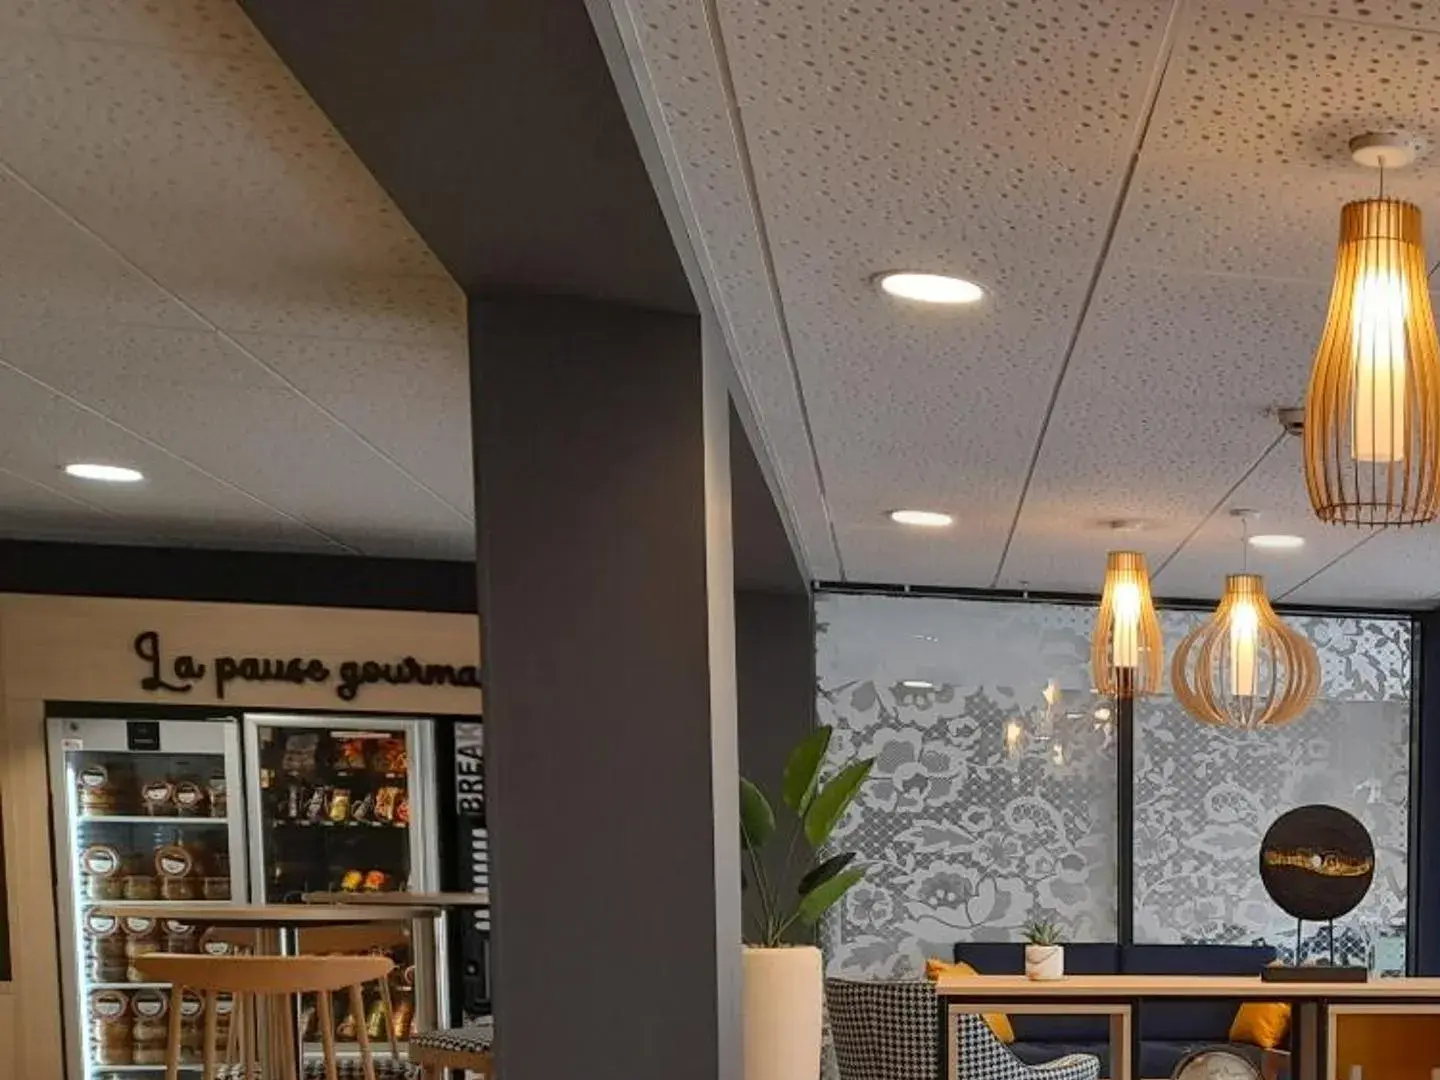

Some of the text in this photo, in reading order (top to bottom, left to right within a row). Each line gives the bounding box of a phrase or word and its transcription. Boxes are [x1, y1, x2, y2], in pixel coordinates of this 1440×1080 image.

[134, 630, 483, 701] La pause gourma
